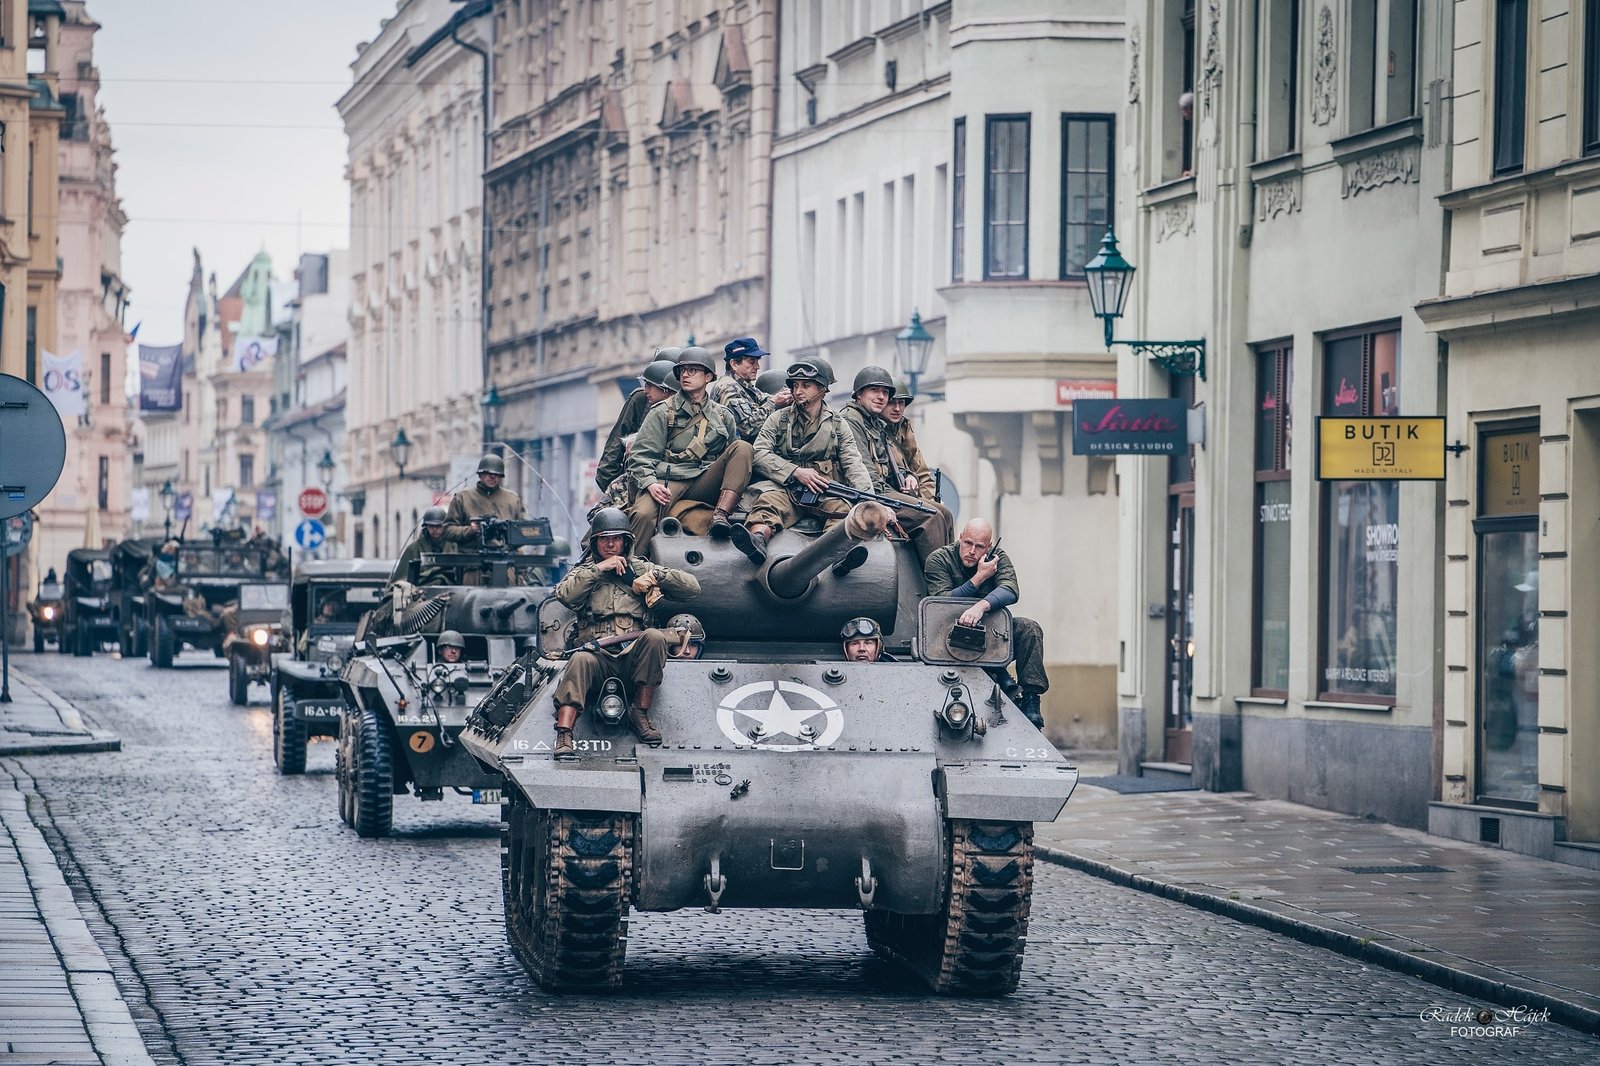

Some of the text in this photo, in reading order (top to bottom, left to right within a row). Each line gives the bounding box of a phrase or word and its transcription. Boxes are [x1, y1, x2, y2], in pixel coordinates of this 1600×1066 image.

[1345, 424, 1419, 440] BUTIK
[1504, 442, 1530, 463] BUTIK
[301, 494, 326, 509] STOP
[305, 705, 315, 717] 16
[417, 735, 427, 749] 7
[513, 739, 529, 750] 16
[1006, 747, 1048, 759] C 23
